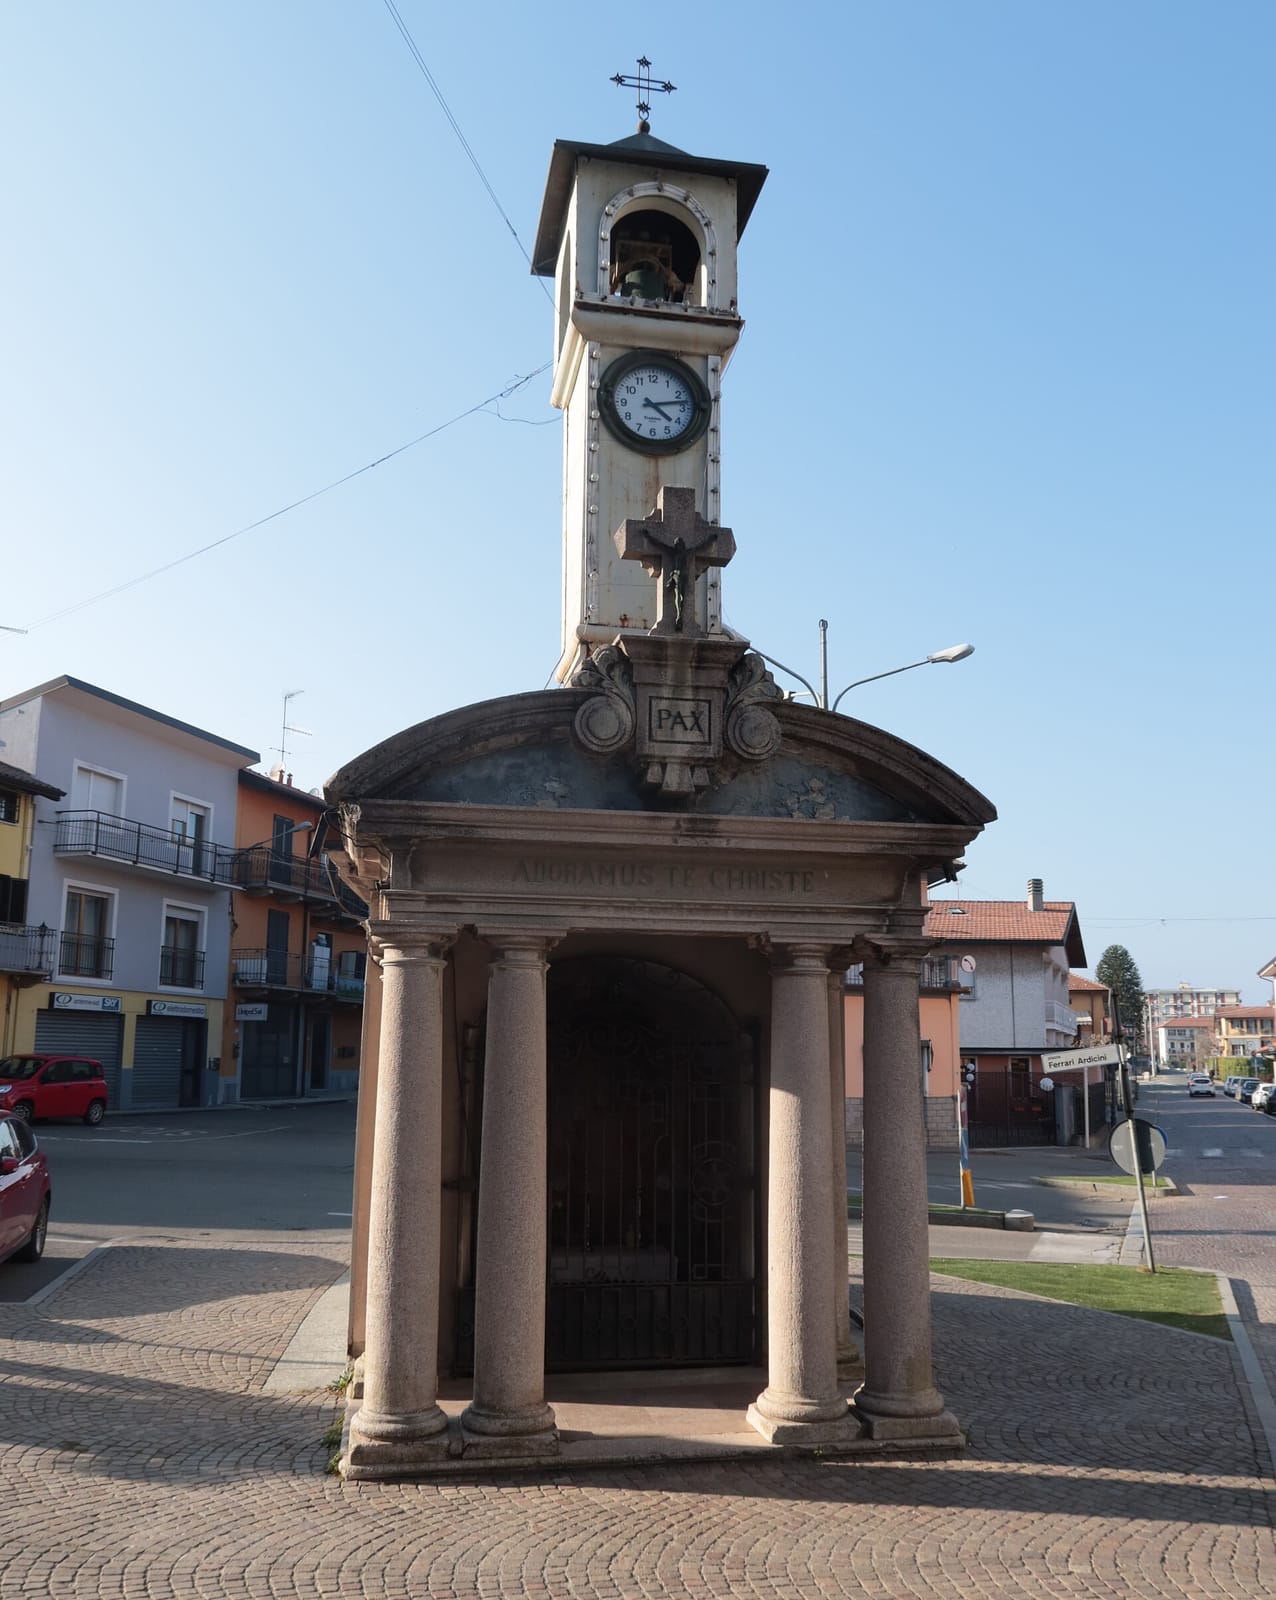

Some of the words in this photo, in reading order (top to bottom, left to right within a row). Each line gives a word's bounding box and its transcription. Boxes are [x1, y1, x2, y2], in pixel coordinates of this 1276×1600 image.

[636, 377, 643, 385] 11
[648, 375, 658, 383] 12
[626, 385, 636, 394] 10
[675, 391, 681, 399] 2
[620, 398, 627, 406] 9
[680, 404, 686, 412] 3
[625, 412, 631, 420] 8
[674, 417, 681, 425] 4
[636, 423, 642, 431] 7
[664, 426, 670, 434] 5
[649, 428, 656, 436] 6
[657, 709, 705, 734] PAX
[511, 859, 655, 886] ADORAMUS
[664, 866, 696, 888] TE
[708, 867, 815, 893] CHRISTE
[1048, 1059, 1075, 1069] Ferrari
[1077, 1054, 1107, 1065] Ardicini
